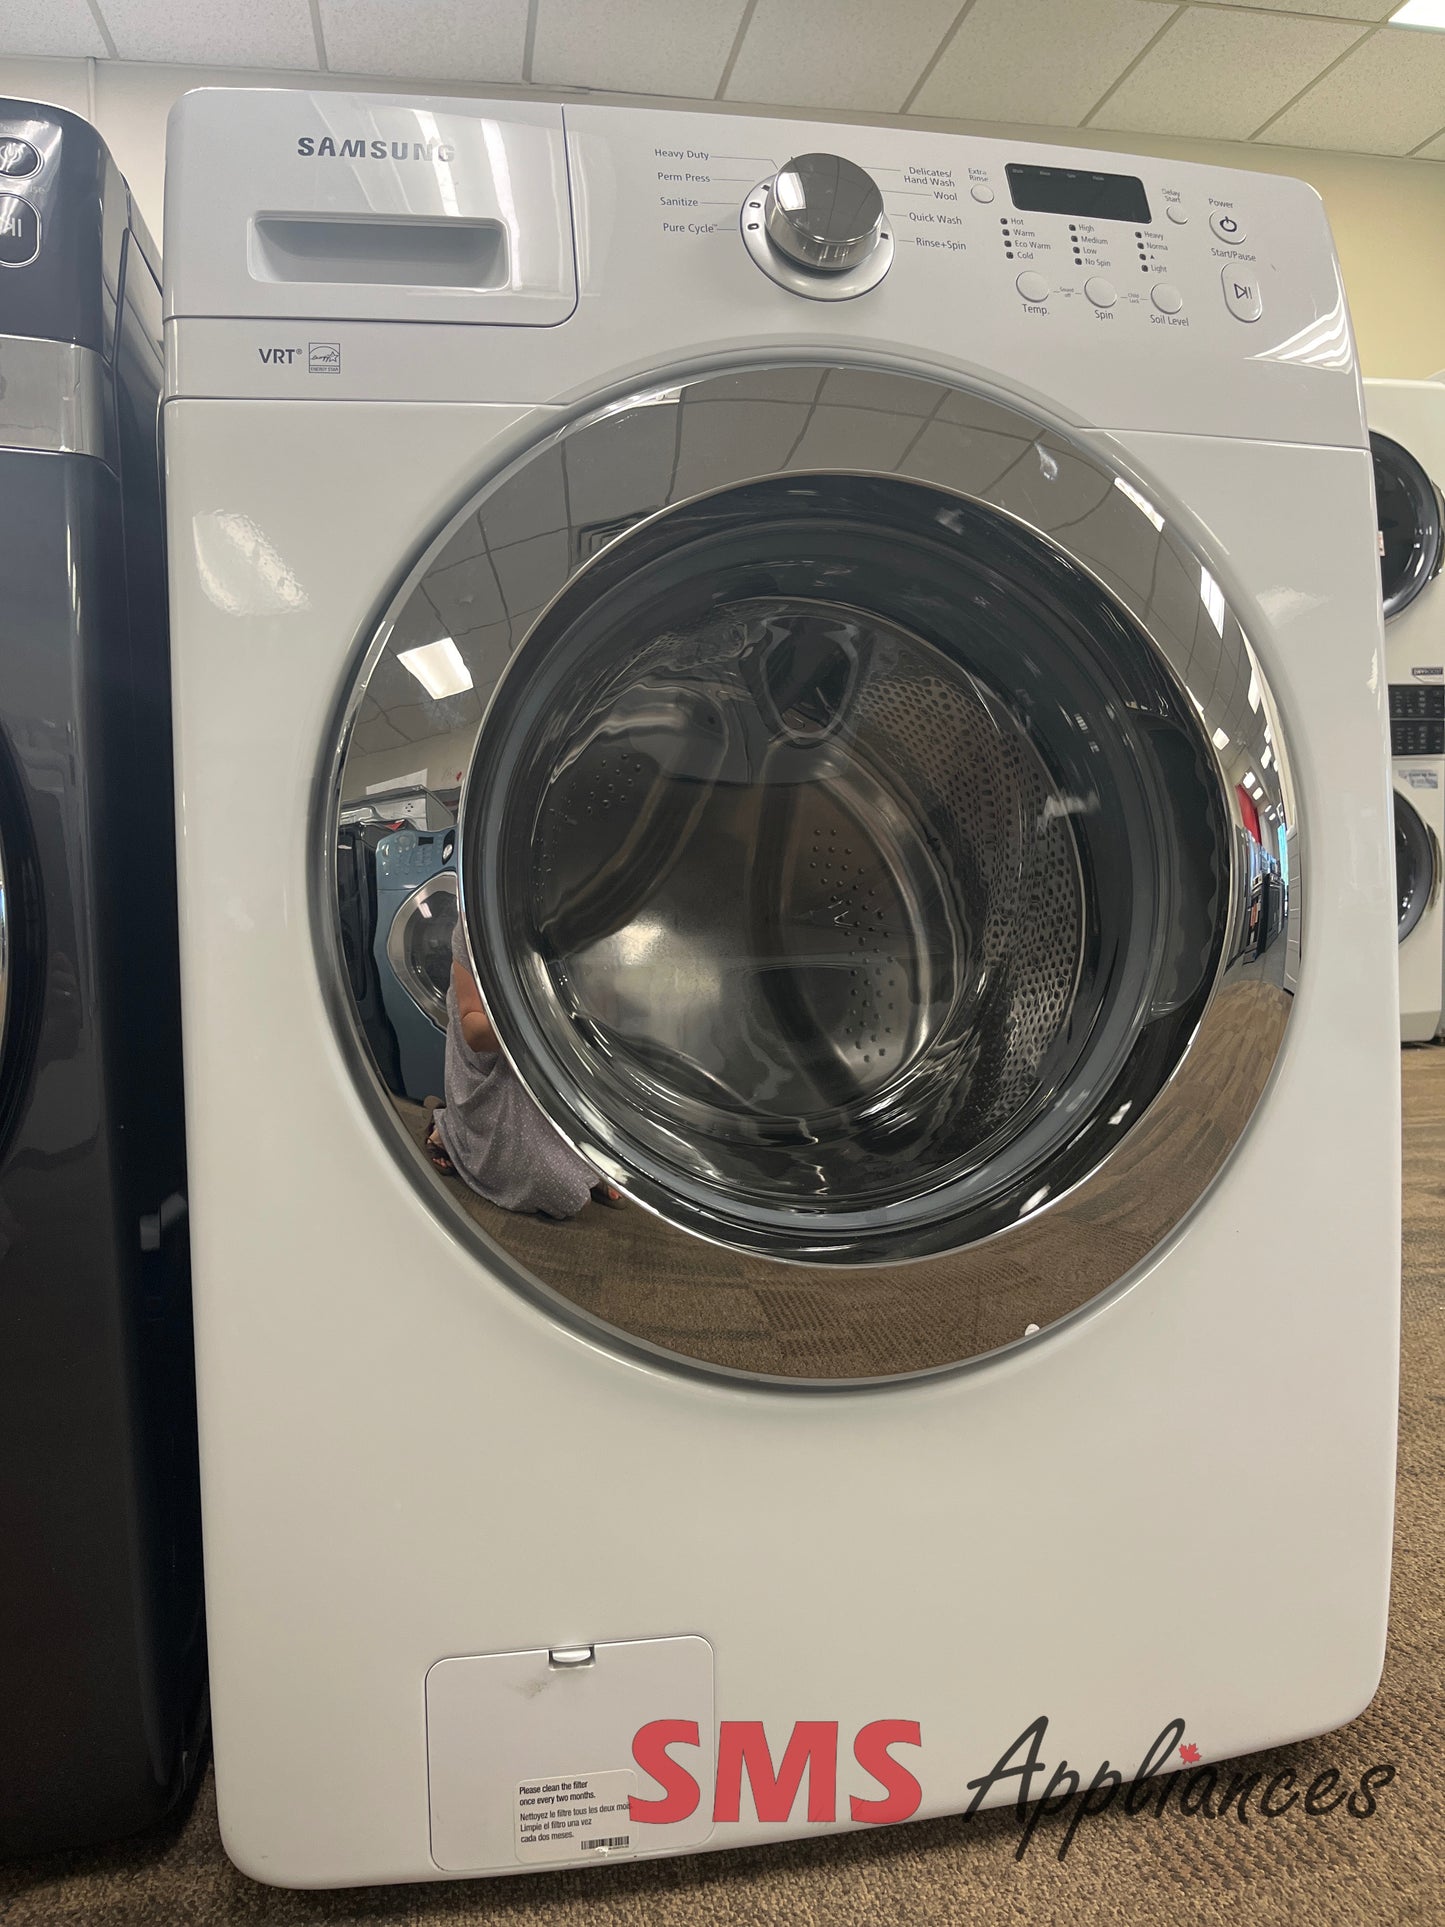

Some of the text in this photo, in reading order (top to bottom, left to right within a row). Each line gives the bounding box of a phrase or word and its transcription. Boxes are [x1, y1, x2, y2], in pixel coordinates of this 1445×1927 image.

[297, 136, 455, 162] SAMSUNG
[654, 148, 709, 161] Heavy Duty
[908, 166, 952, 178] Delicates/
[968, 167, 987, 176] Extra
[657, 172, 711, 183] Perm Press
[904, 175, 956, 188] Hand Wash
[969, 174, 988, 182] Rinse
[933, 190, 958, 201] Wool
[660, 196, 699, 207] Sanitize
[1208, 197, 1234, 209] Power
[909, 211, 963, 226] Quick Wash
[1010, 217, 1024, 226] Hot
[663, 223, 686, 234] Pure
[1013, 229, 1035, 238] Warm
[1078, 223, 1095, 233] High
[1081, 235, 1109, 245] Medium
[1144, 231, 1164, 241] Heavy
[915, 237, 967, 251] Rinse+Spin
[1014, 240, 1051, 250] Eco Warm
[1017, 252, 1034, 260] Cold
[1082, 246, 1097, 255] Low
[1210, 247, 1257, 262] Start/Pause
[1085, 257, 1111, 268] No Spin
[1150, 264, 1168, 273] Light
[1022, 303, 1050, 316] Temp.
[1094, 309, 1114, 321] Spin
[1150, 313, 1190, 327] Soil Level
[519, 1780, 588, 1795] Please clean the filter
[519, 1791, 596, 1806] once every two months.
[520, 1810, 549, 1822] Nettoyez
[549, 1809, 556, 1819] le
[557, 1808, 572, 1818] filtre
[573, 1807, 587, 1816] tous
[588, 1805, 598, 1814] les
[599, 1803, 615, 1813] deux
[520, 1817, 592, 1833] Limpie el filtro una vez
[520, 1830, 574, 1843] cada dos meses.
